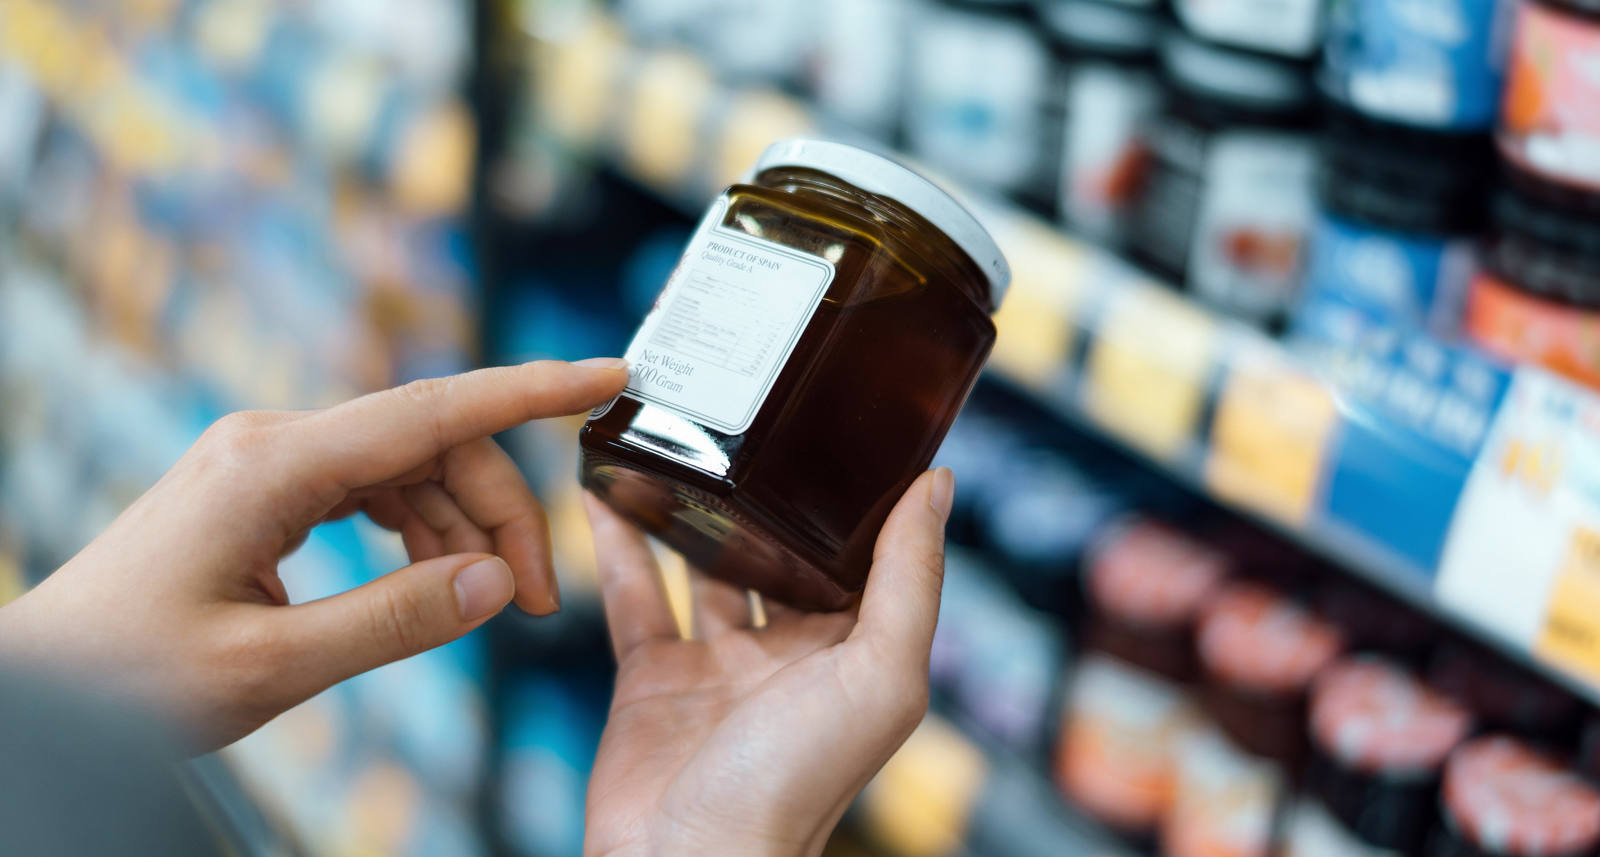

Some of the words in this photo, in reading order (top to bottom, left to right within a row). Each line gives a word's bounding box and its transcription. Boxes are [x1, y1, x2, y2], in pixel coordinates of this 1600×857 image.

[701, 250, 724, 266] Quality
[726, 258, 746, 272] Grade
[706, 241, 746, 258] PRODUCT
[746, 254, 758, 263] OF
[757, 257, 782, 271] SPAIN
[640, 348, 659, 364] Net
[661, 354, 694, 376] Weight
[633, 363, 658, 383] 500
[656, 374, 684, 393] Gram
